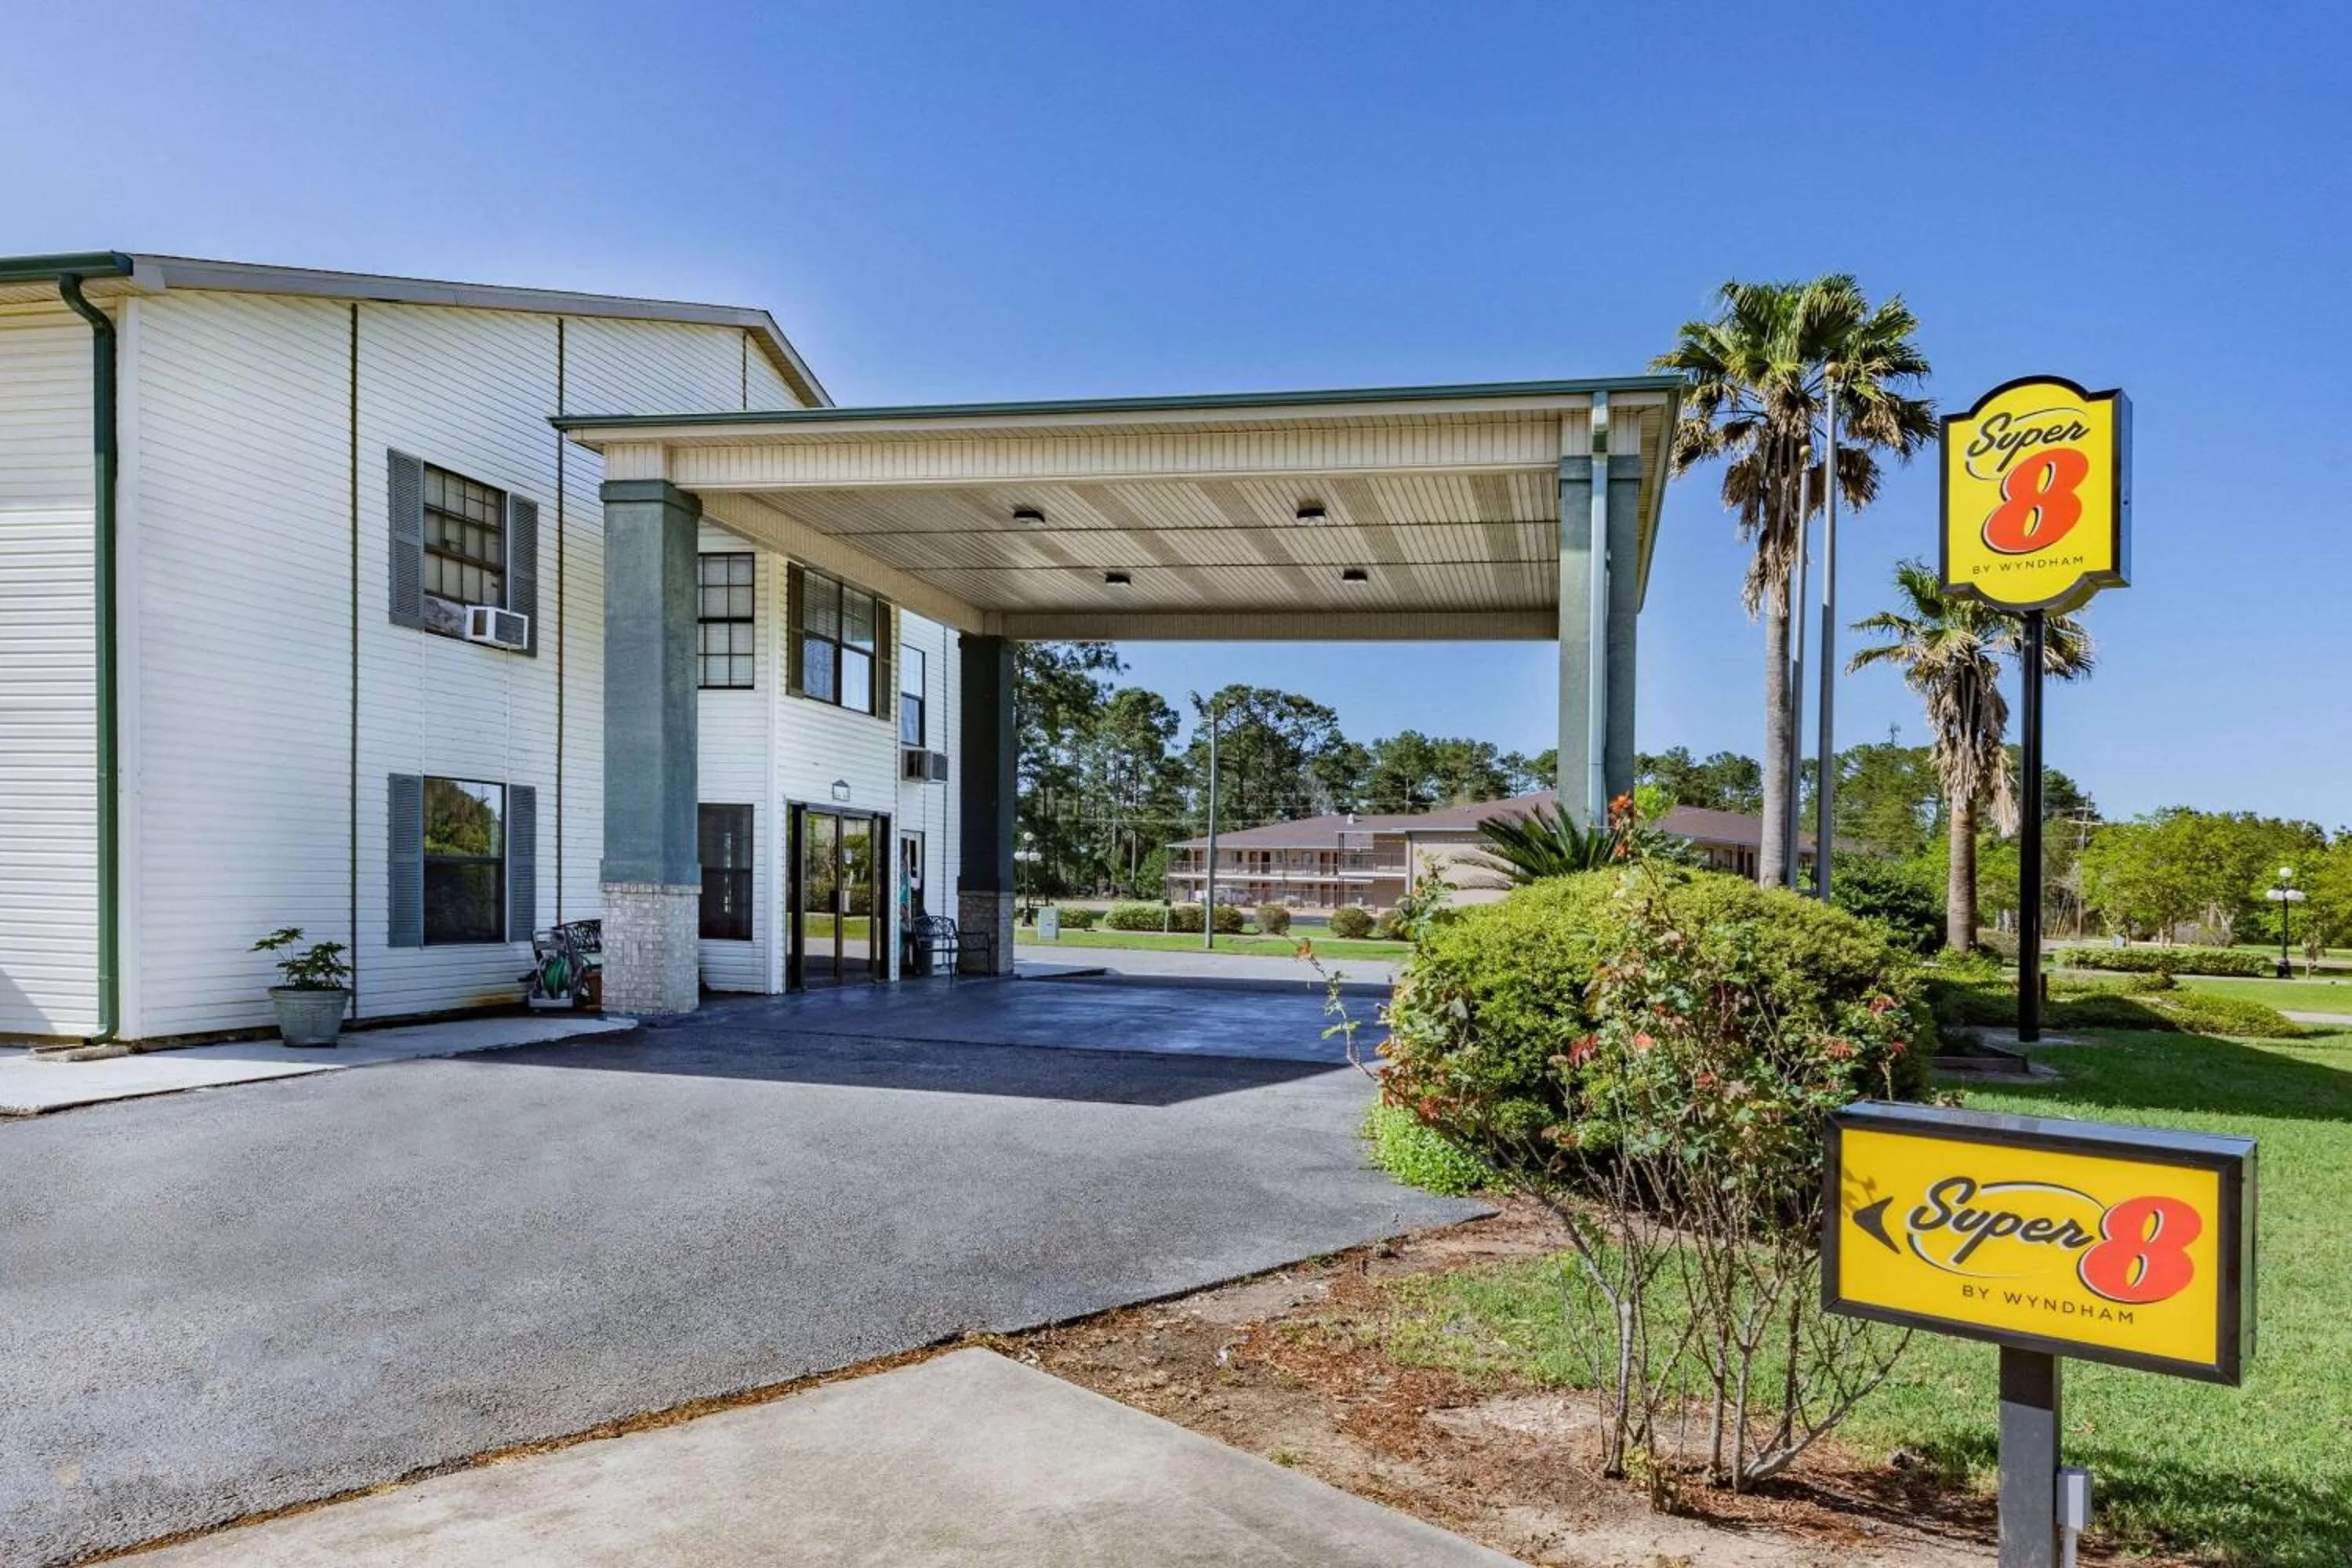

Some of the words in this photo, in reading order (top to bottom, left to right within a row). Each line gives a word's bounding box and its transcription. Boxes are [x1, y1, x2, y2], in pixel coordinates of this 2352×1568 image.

[1966, 412, 2091, 473] Super
[1980, 448, 2089, 555] 8
[1972, 564, 1991, 575] BY
[1999, 555, 2085, 572] WYNDHAM
[1908, 1176, 2097, 1265] Super
[2077, 1196, 2204, 1305] 8
[1962, 1284, 1991, 1300] BY
[2003, 1291, 2135, 1325] WYNDHAM
